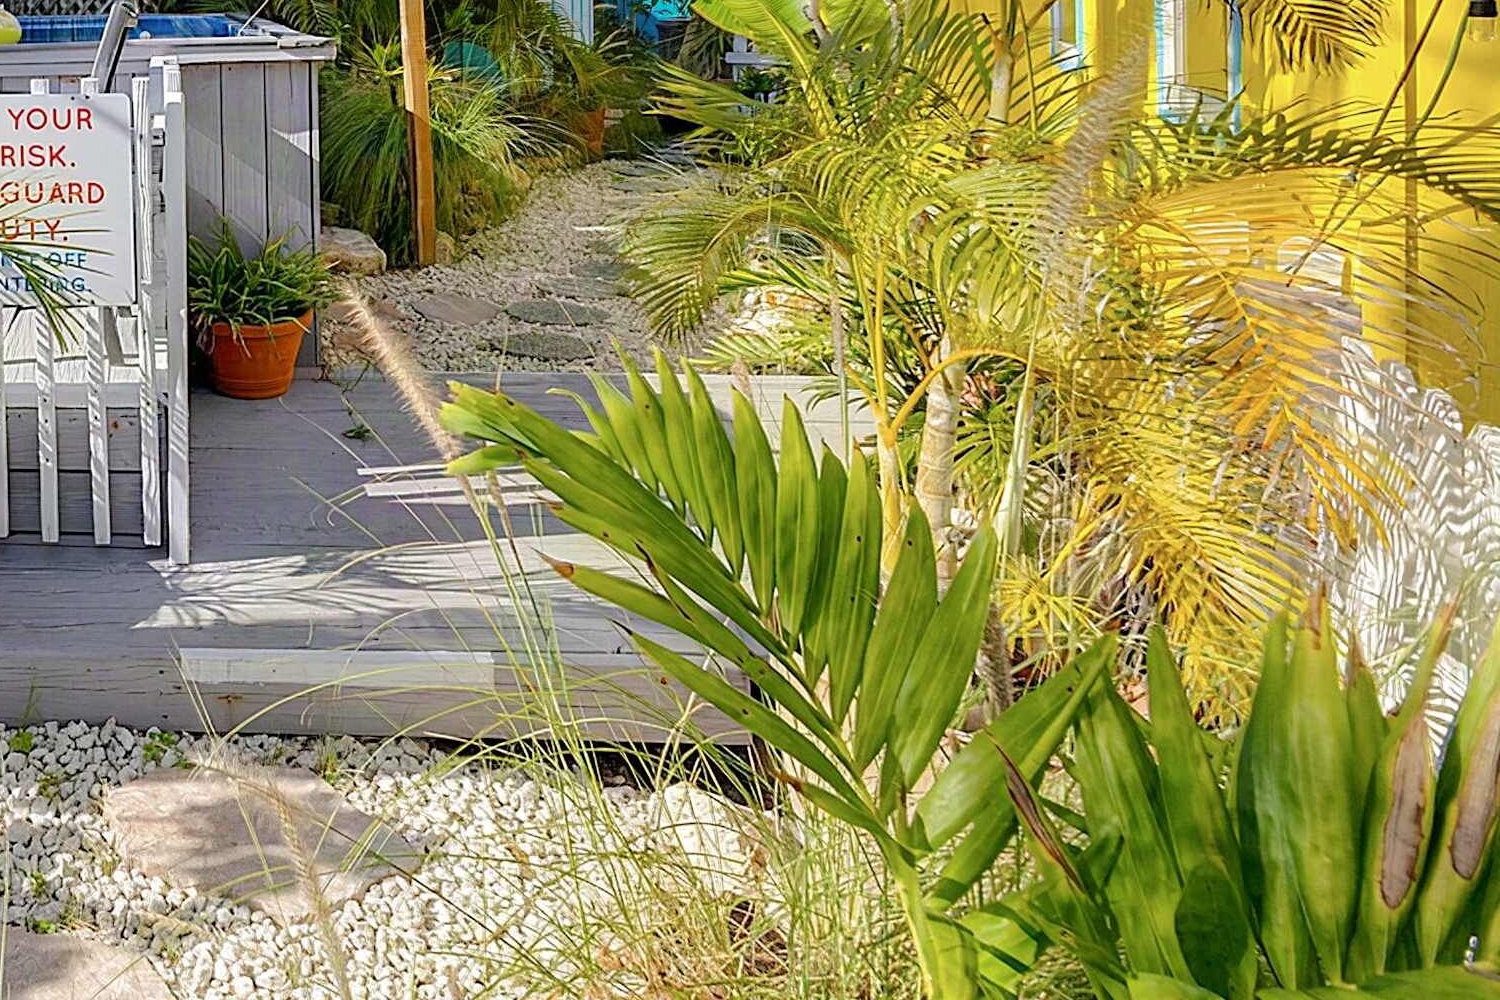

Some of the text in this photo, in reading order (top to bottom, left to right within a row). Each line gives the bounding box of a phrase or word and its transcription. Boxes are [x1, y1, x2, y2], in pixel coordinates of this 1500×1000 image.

[7, 108, 93, 131] YOUR
[0, 144, 76, 168] RISK.
[47, 252, 88, 268] OFF
